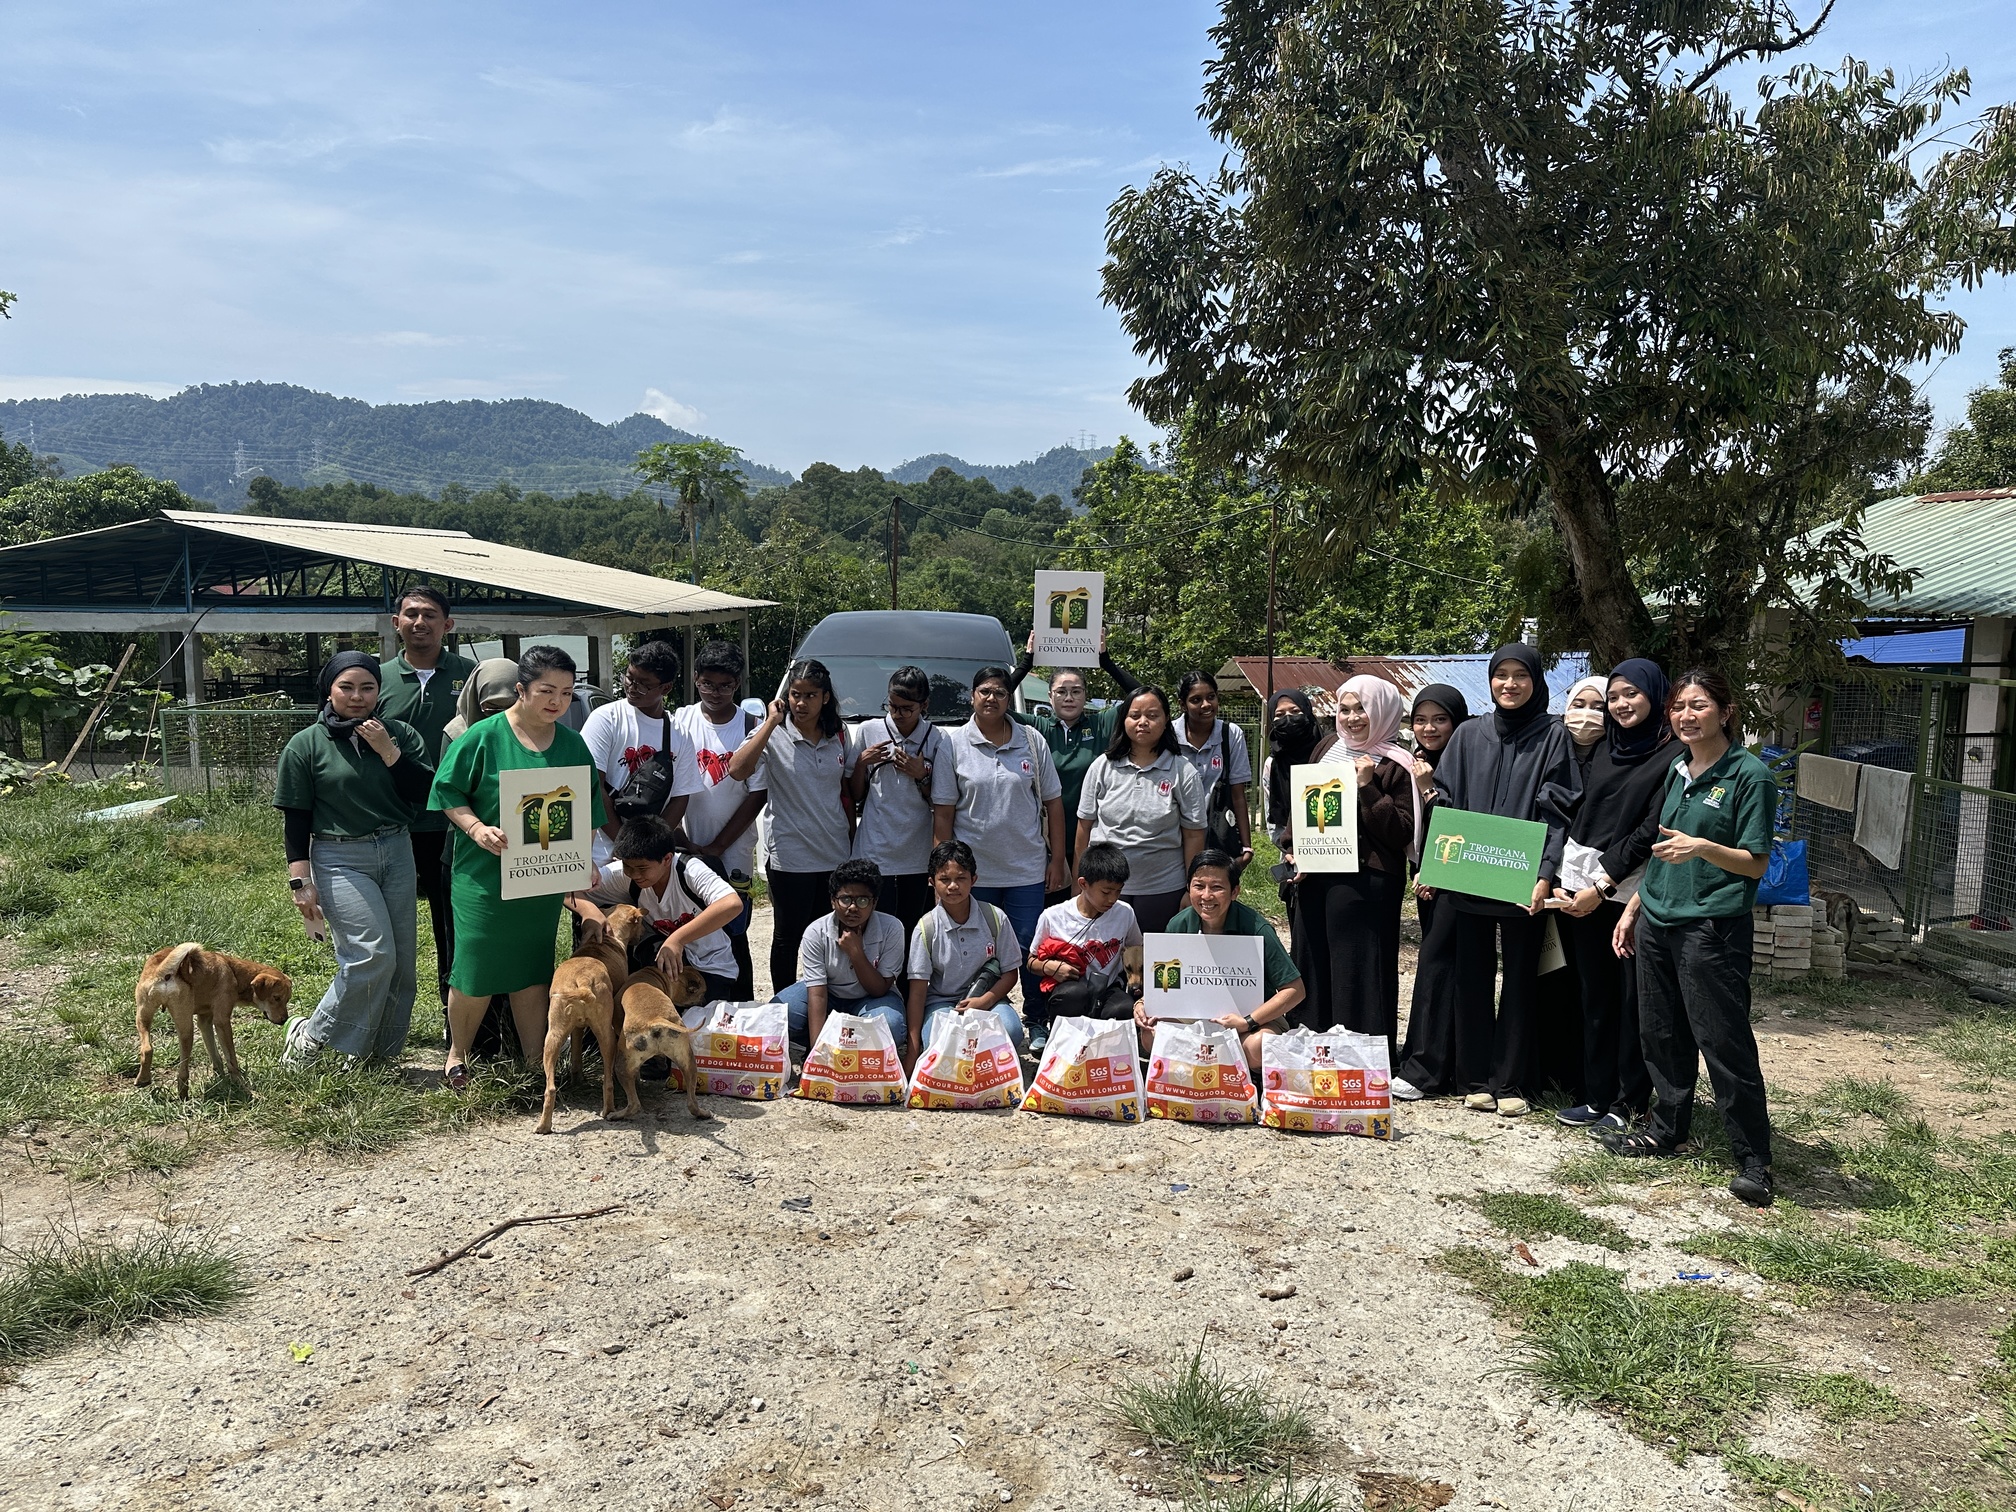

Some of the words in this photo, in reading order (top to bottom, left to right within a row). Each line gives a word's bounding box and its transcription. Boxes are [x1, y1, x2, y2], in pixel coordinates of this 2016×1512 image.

[1042, 636, 1092, 644] TROPICANA
[1300, 837, 1348, 845] TROPICANA
[1298, 847, 1352, 856] FOUNDATION
[1468, 842, 1527, 860] TROPICANA
[514, 851, 581, 866] TROPICANA
[1462, 852, 1530, 870] FOUNDATION
[509, 862, 586, 879] FOUNDATION
[1188, 965, 1252, 976] TROPICANA
[1184, 976, 1258, 987] FOUNDATION
[740, 1044, 759, 1052] SGS
[976, 1059, 993, 1071] SGS
[1090, 1067, 1108, 1077] SGS
[1223, 1073, 1240, 1081] SGS
[932, 1079, 951, 1088] YOUR
[986, 1073, 1012, 1085] LONGER
[1342, 1079, 1361, 1088] SGS
[1045, 1081, 1060, 1093] YOUR
[1098, 1084, 1127, 1094] LONGER
